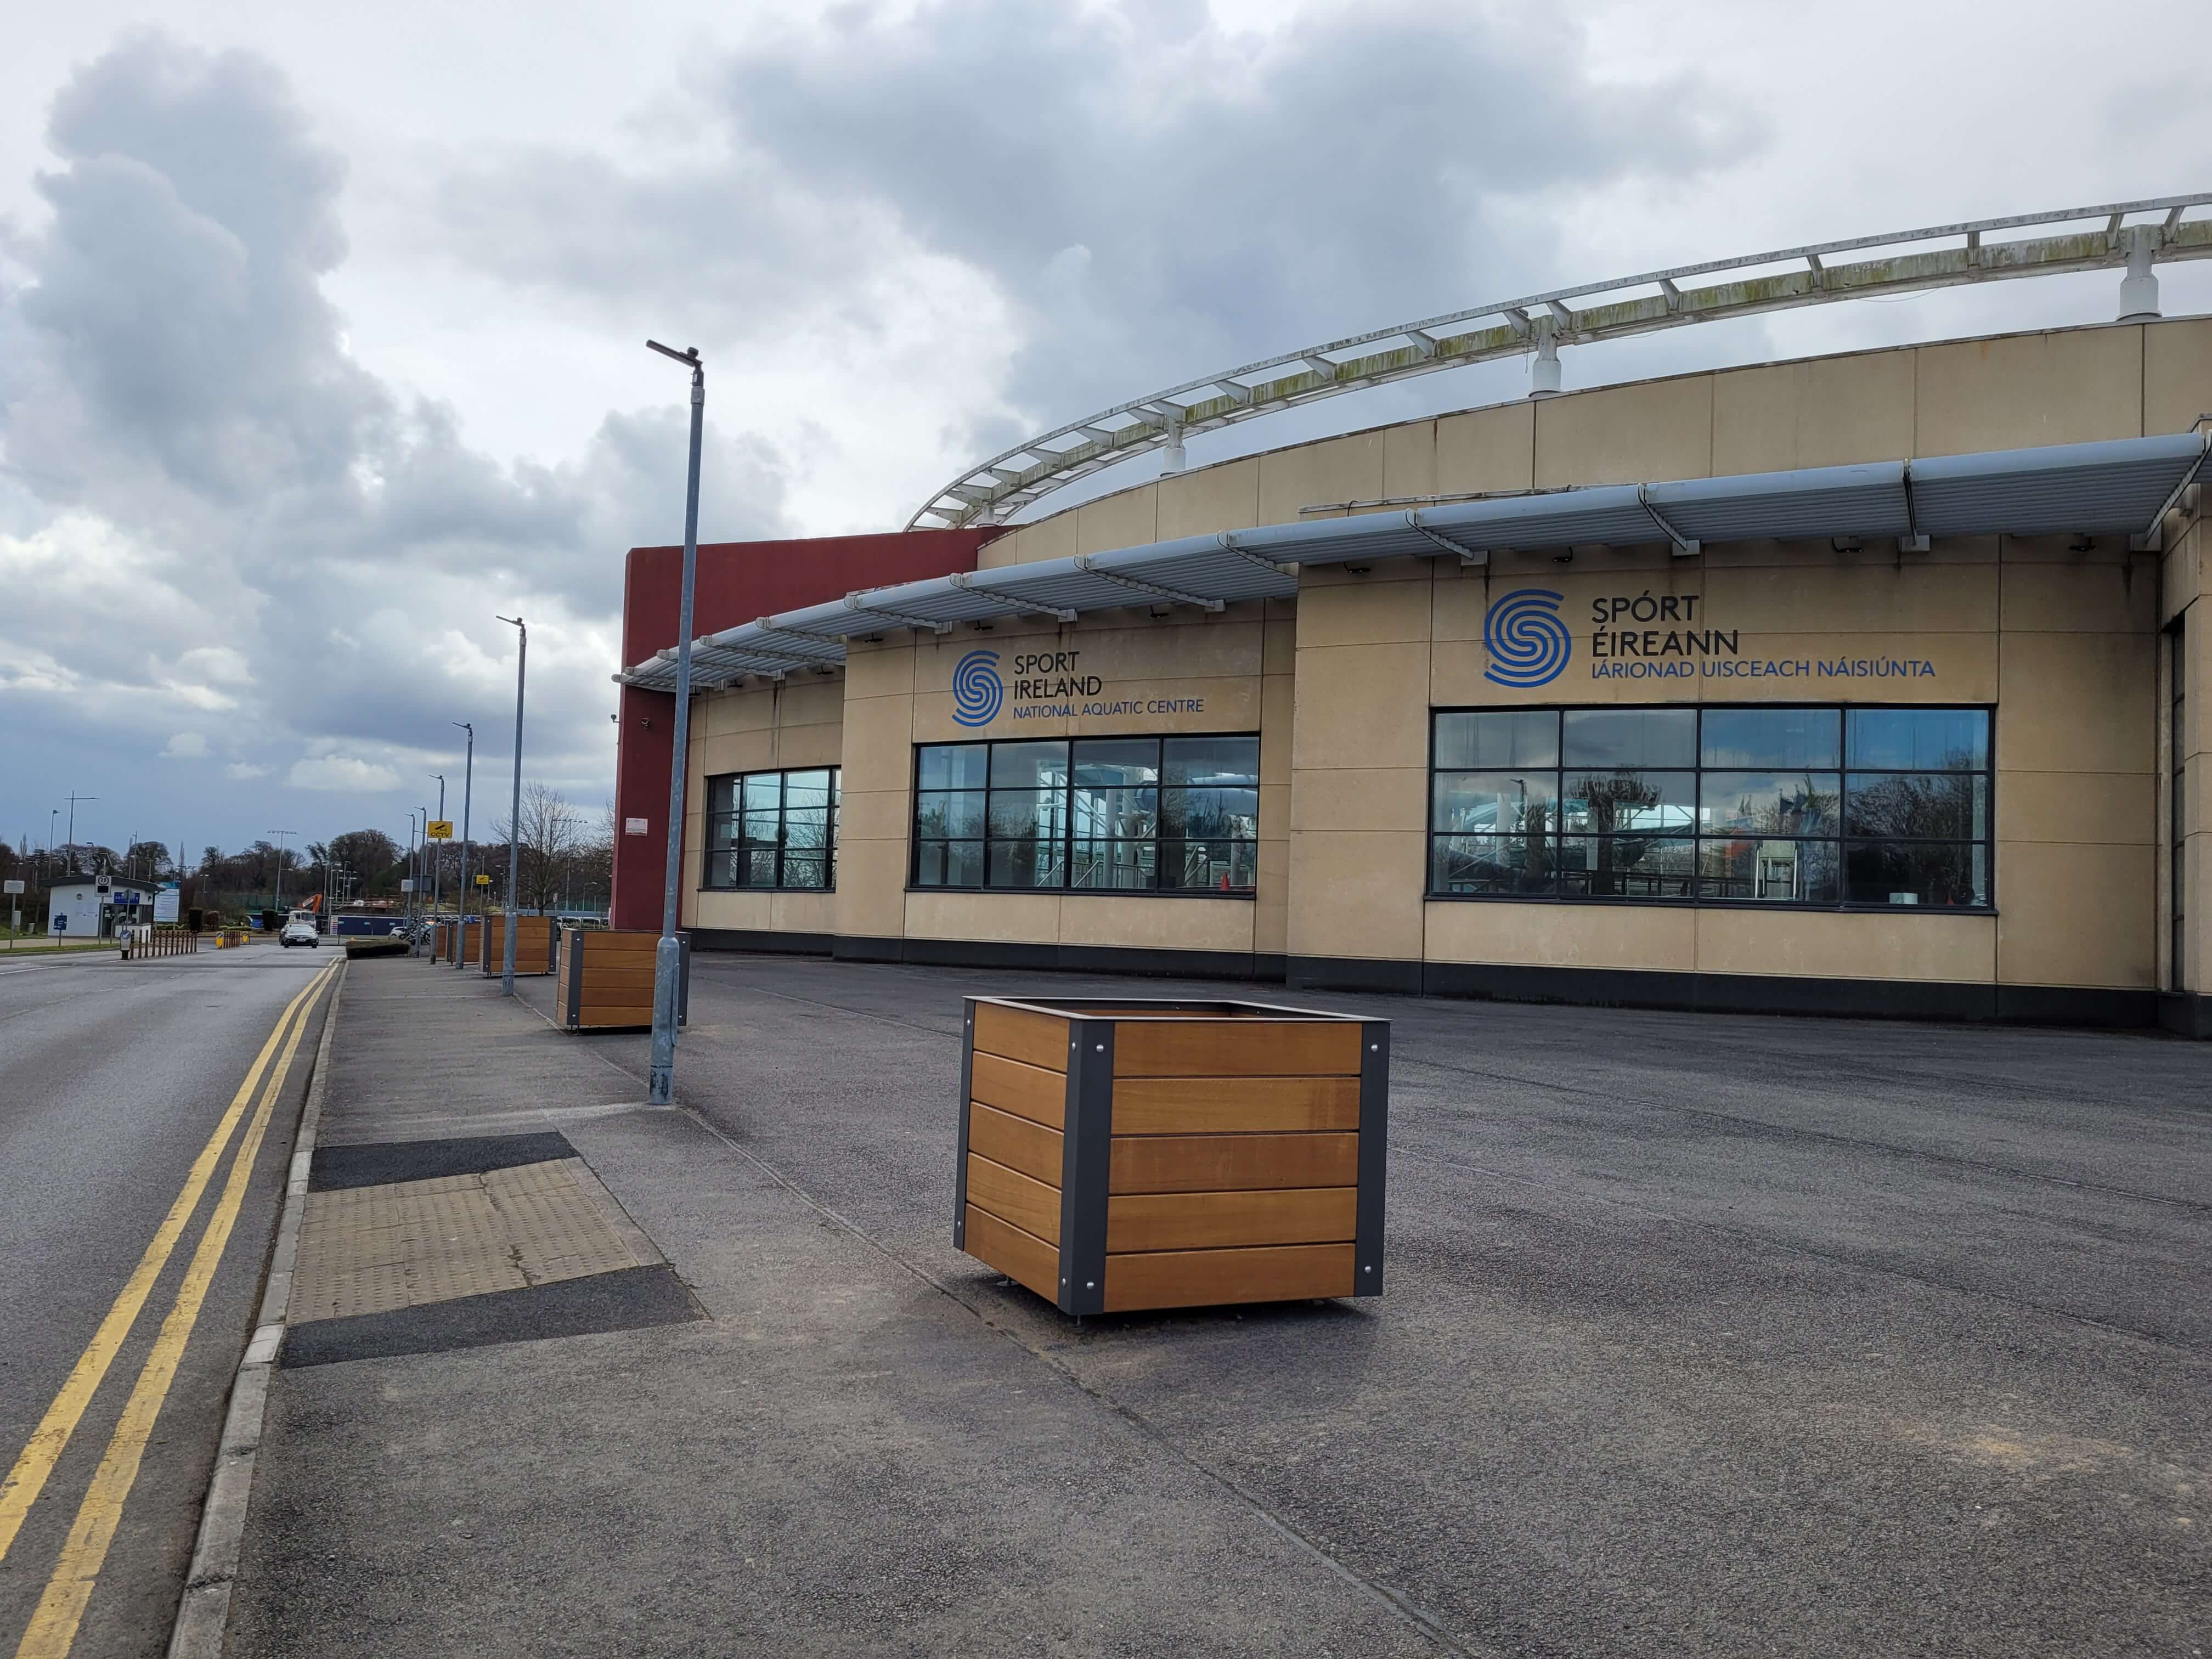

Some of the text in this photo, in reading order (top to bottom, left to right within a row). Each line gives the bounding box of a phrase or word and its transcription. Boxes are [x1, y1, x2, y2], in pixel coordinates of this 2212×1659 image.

[1592, 590, 1700, 624] SPÓRT
[1593, 625, 1739, 657] ÉIREANN
[1014, 651, 1080, 675] SPORT
[1592, 656, 1936, 679] LÁRIONAD UISCEACH NÁISIÚNTA
[1014, 676, 1102, 700] IRELAND
[1013, 699, 1205, 720] NATIONAL AQUATIC CENTRE
